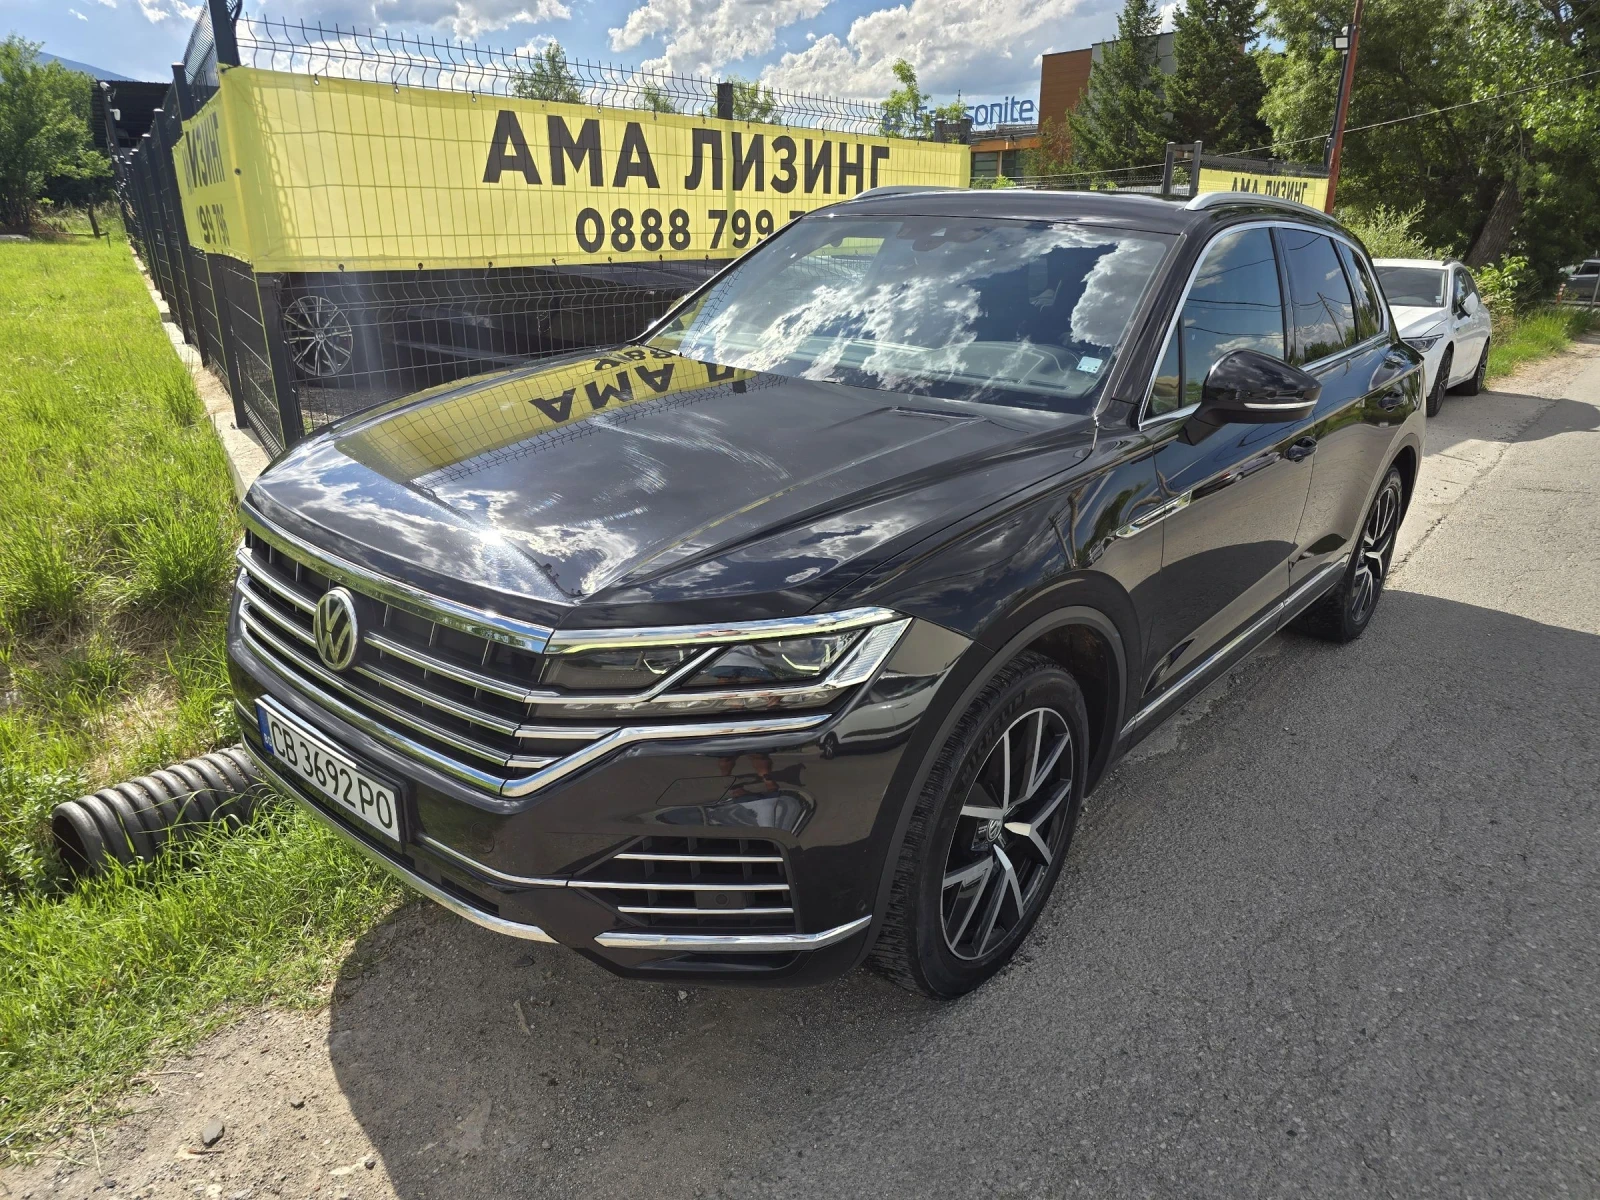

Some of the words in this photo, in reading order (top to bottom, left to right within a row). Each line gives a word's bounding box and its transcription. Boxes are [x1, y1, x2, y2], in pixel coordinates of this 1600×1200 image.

[483, 110, 660, 188] АМА
[685, 128, 890, 194] ЛИЗИНГ
[576, 207, 691, 253] 0888
[709, 209, 775, 249] 799
